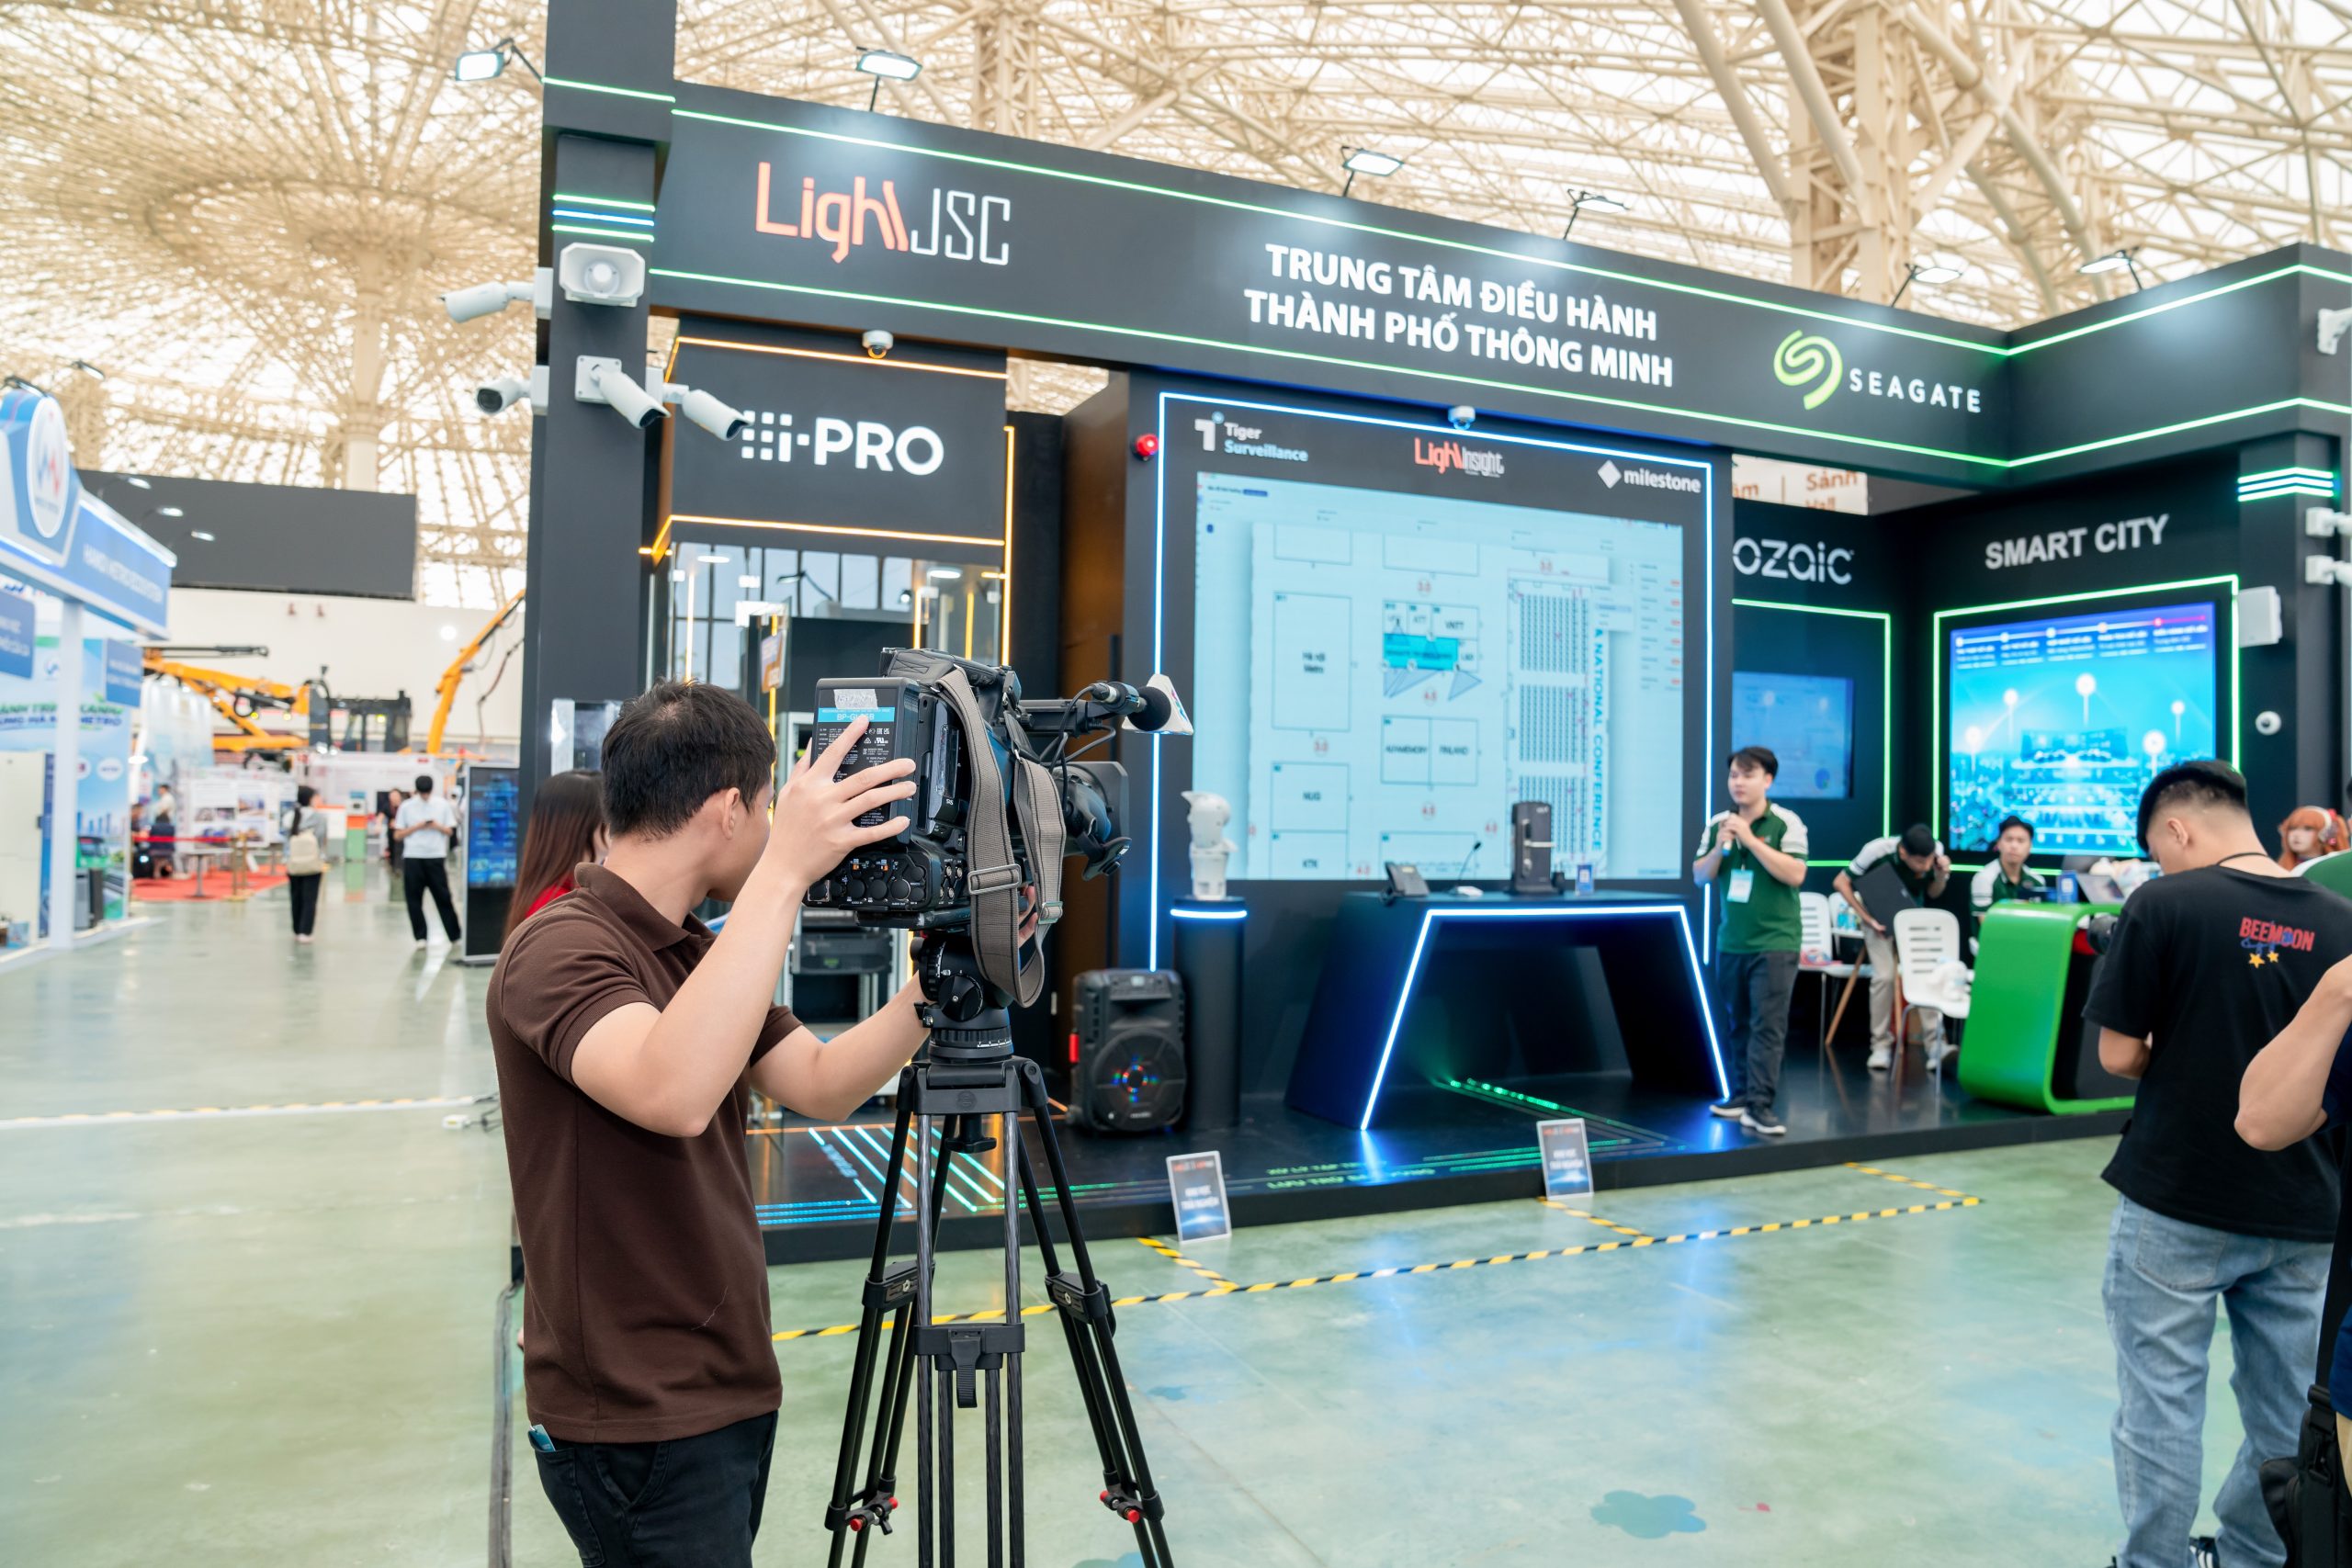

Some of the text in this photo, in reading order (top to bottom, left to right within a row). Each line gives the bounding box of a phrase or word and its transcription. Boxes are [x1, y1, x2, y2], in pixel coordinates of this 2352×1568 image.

[1266, 243, 1657, 342] TRUNG TÂM ĐIỀU HÀNH
[1244, 287, 1673, 388] THÀNH PHỐ THÔNG MINH
[1849, 366, 1983, 413] SEAGATE
[1224, 422, 1262, 441] Tiger
[1224, 439, 1309, 462] Surveillance
[1623, 468, 1702, 493] milestone
[1985, 513, 2168, 570] SMART CITY
[1593, 643, 1603, 728] NATIONAL
[1592, 734, 1603, 852] CONFERENCE
[2240, 917, 2315, 952] BEEMOON
